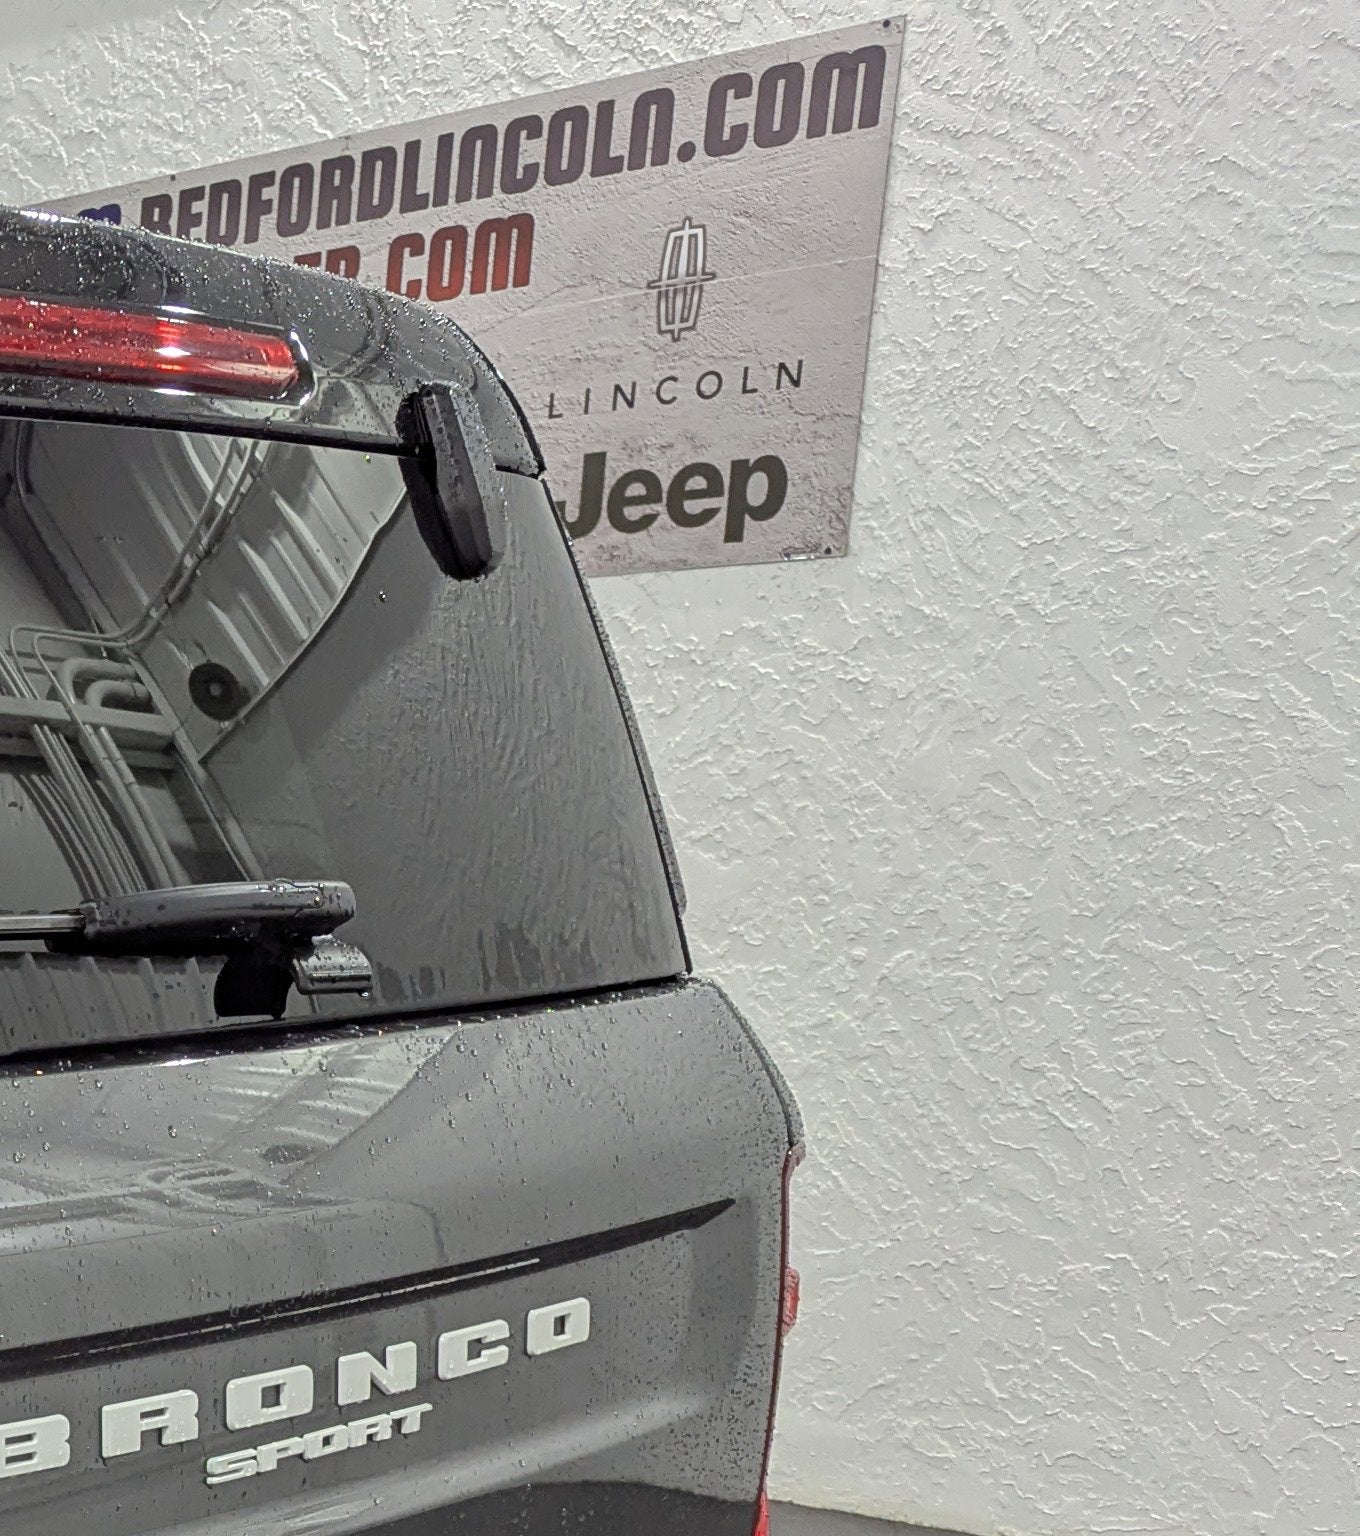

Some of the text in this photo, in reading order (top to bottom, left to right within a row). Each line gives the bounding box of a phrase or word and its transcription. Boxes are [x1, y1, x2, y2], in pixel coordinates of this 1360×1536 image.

[548, 359, 803, 419] LINCOLN
[555, 451, 788, 544] Jeep
[205, 1402, 433, 1486] SPORT
